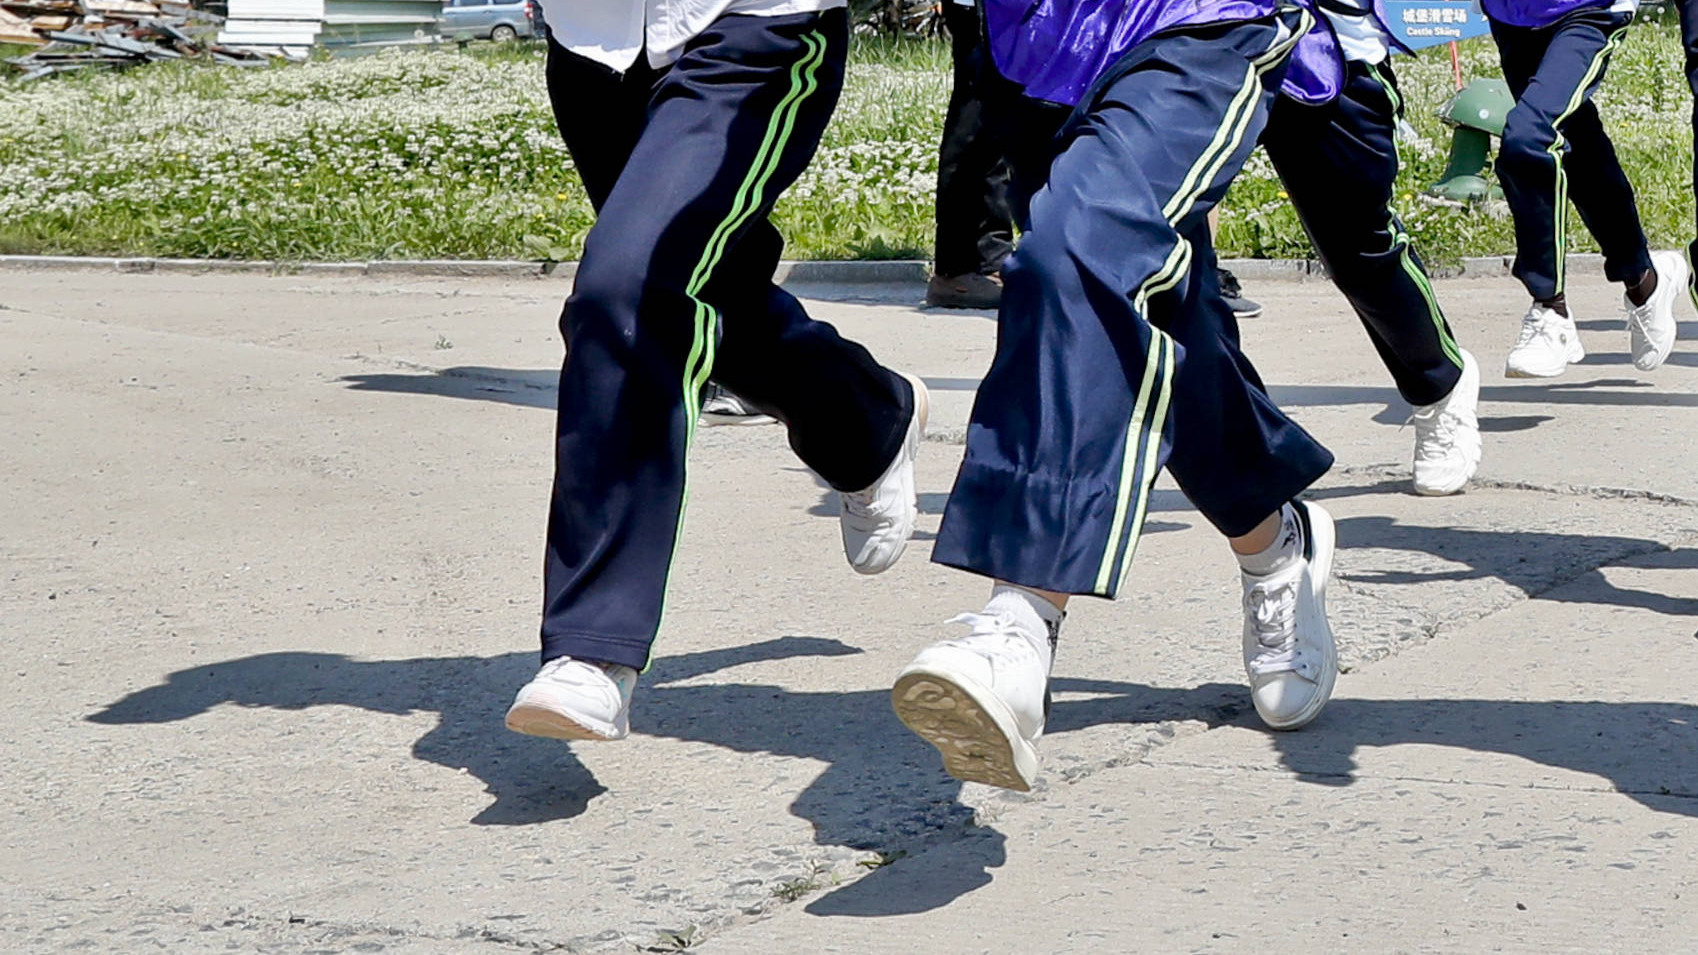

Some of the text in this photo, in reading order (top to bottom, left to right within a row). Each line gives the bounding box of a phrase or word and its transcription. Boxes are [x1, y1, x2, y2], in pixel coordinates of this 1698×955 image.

[1402, 8, 1467, 23] 城堡滑雪场
[1406, 27, 1461, 37] Castle Skiing
